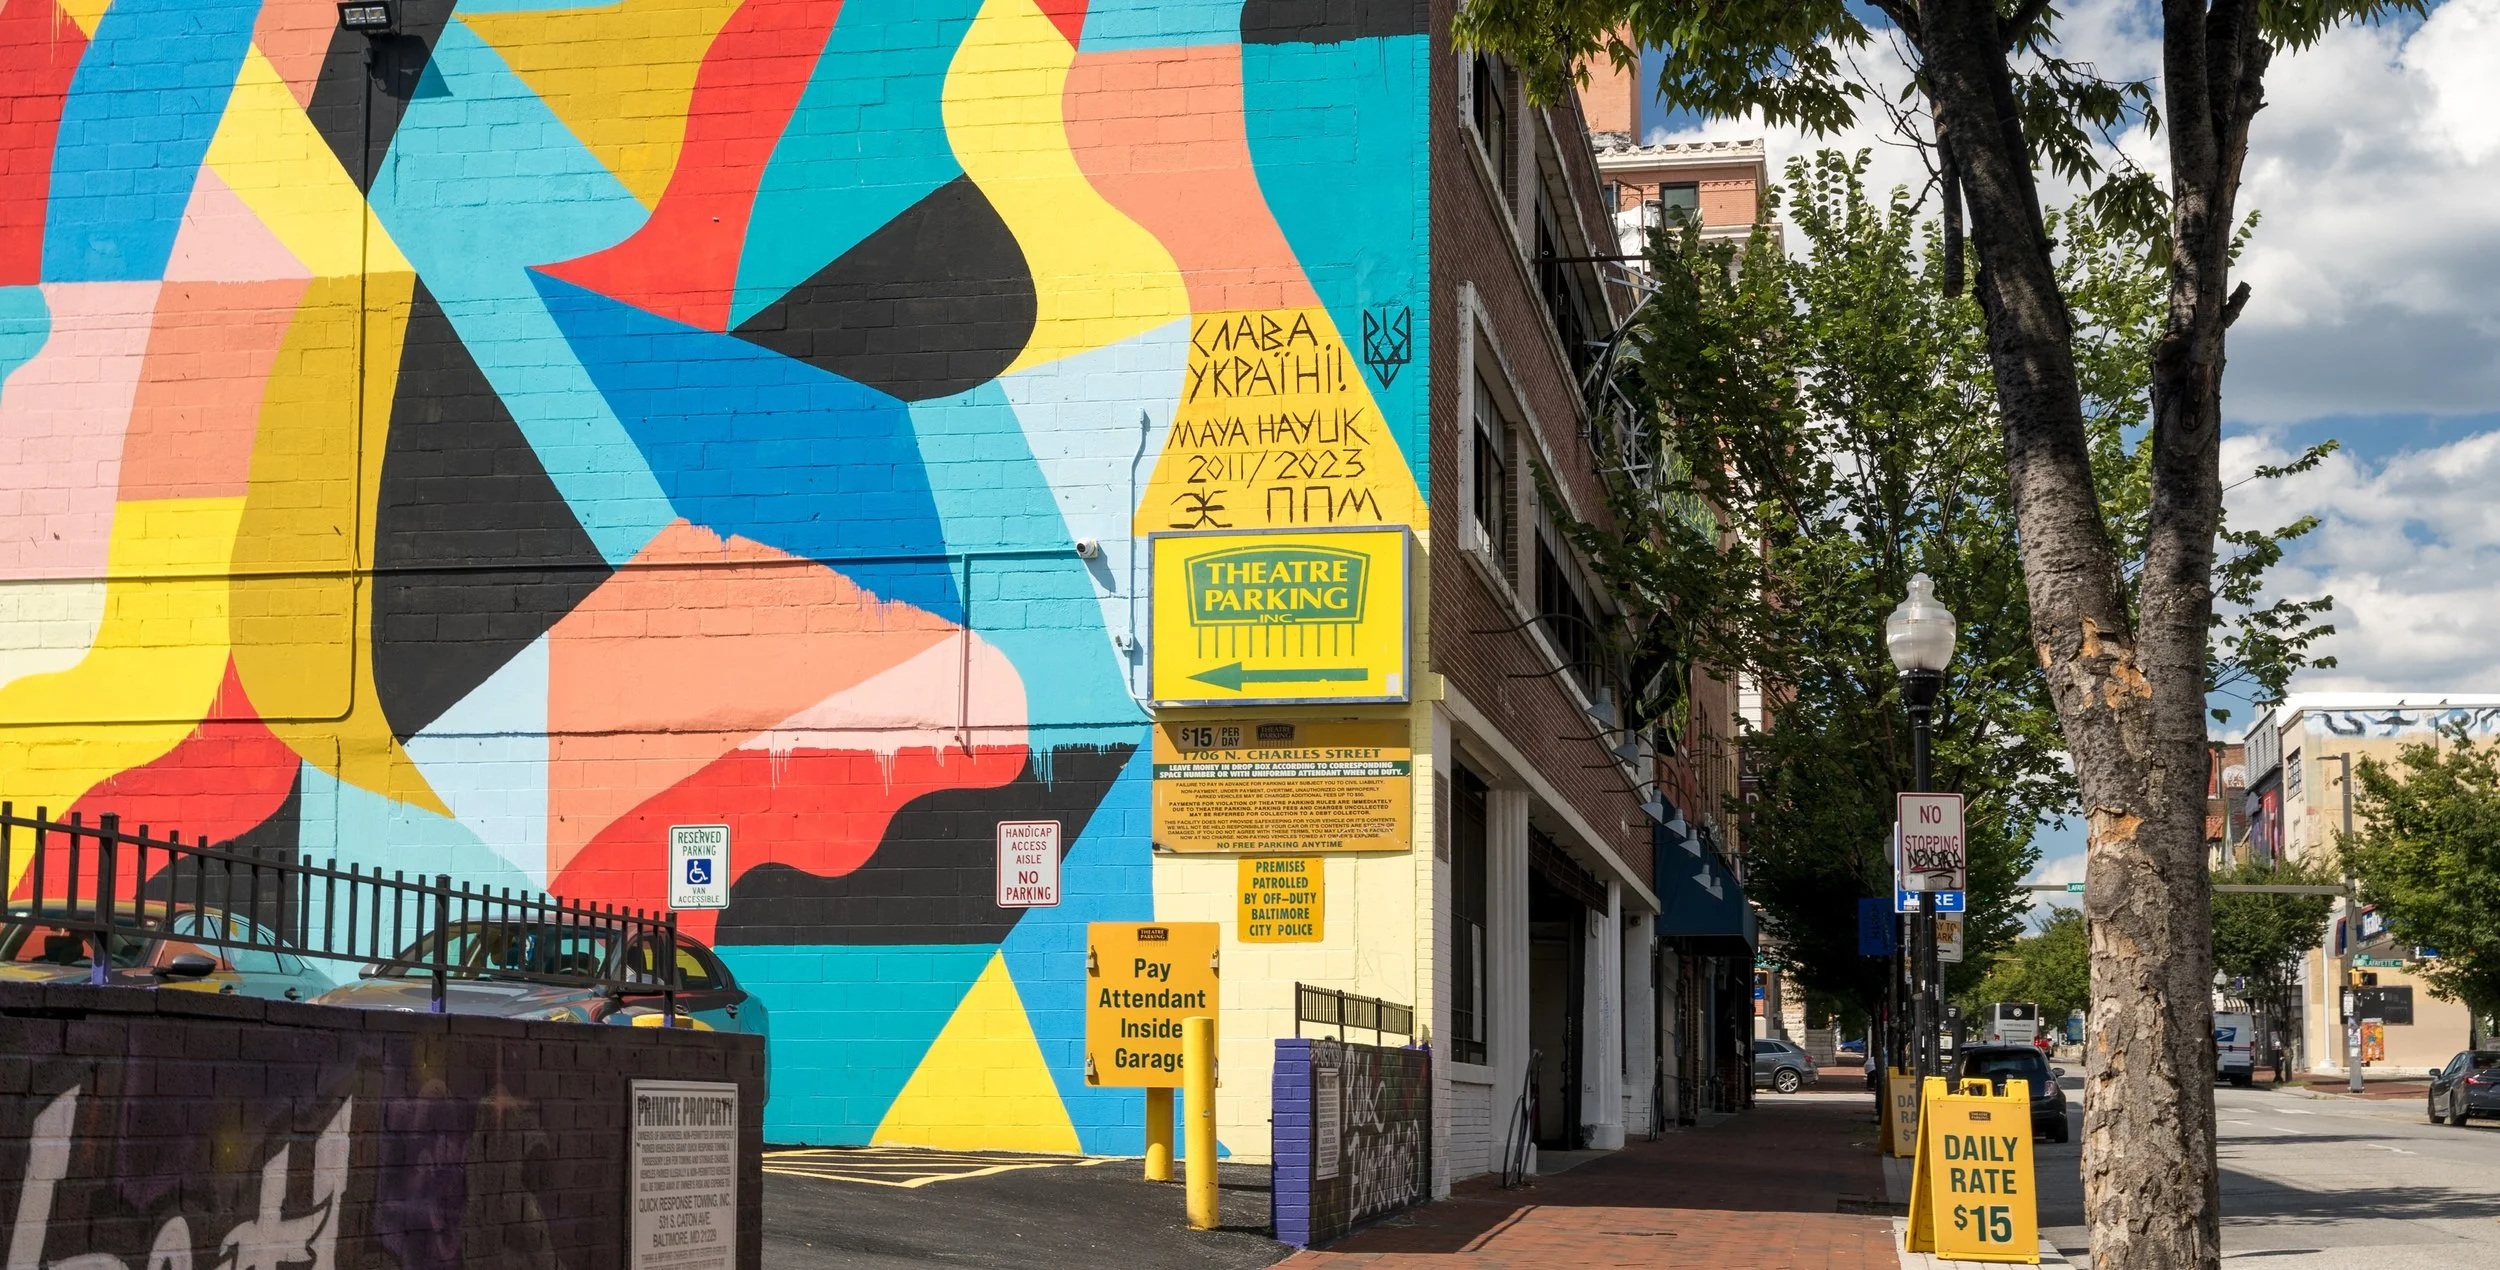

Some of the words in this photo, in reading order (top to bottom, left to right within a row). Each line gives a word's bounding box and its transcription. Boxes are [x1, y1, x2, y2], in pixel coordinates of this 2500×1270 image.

[1192, 312, 1318, 357] СЛАВА
[1168, 414, 1250, 449] MAYA
[1258, 407, 1370, 446] HAYUK
[1206, 560, 1348, 585] THEATRE
[1205, 586, 1348, 611] PARKING
[1259, 613, 1293, 623] INC
[1222, 727, 1239, 737] PER
[1222, 737, 1239, 746] DAY
[1182, 751, 1219, 760] 1706
[1225, 751, 1240, 760] N.
[1247, 750, 1320, 760] CHARLES
[1326, 749, 1381, 758] STREET
[1920, 805, 1941, 824] NO
[678, 831, 721, 844] RESERVED
[1006, 828, 1052, 837] HANDICAP
[1012, 841, 1047, 851] ACCESS
[1905, 835, 1958, 852] STOPPING
[683, 845, 716, 856] PARKING
[1016, 855, 1041, 864] AISLE
[1256, 861, 1305, 873] PREMISES
[1019, 871, 1038, 884] NO
[1253, 877, 1308, 889] PATROLLED
[1007, 887, 1051, 900] PARKING
[1244, 893, 1257, 904] BY
[1264, 893, 1317, 904] OFF-DUTY
[1252, 908, 1309, 920] BALTIMORE
[1250, 925, 1271, 936] CITY
[1278, 924, 1313, 935] POLICE
[1134, 958, 1171, 982] Pay
[1099, 988, 1206, 1008] Attendant
[1121, 1018, 1183, 1038] Inside
[638, 1095, 681, 1126] PRIVATE
[683, 1097, 733, 1127] PROPERTY
[1944, 1134, 2018, 1162] DAILY
[1950, 1168, 2017, 1194] RATE
[638, 1196, 658, 1213] QUICK
[659, 1195, 693, 1211] RESPONSE
[1954, 1204, 2012, 1242] $15
